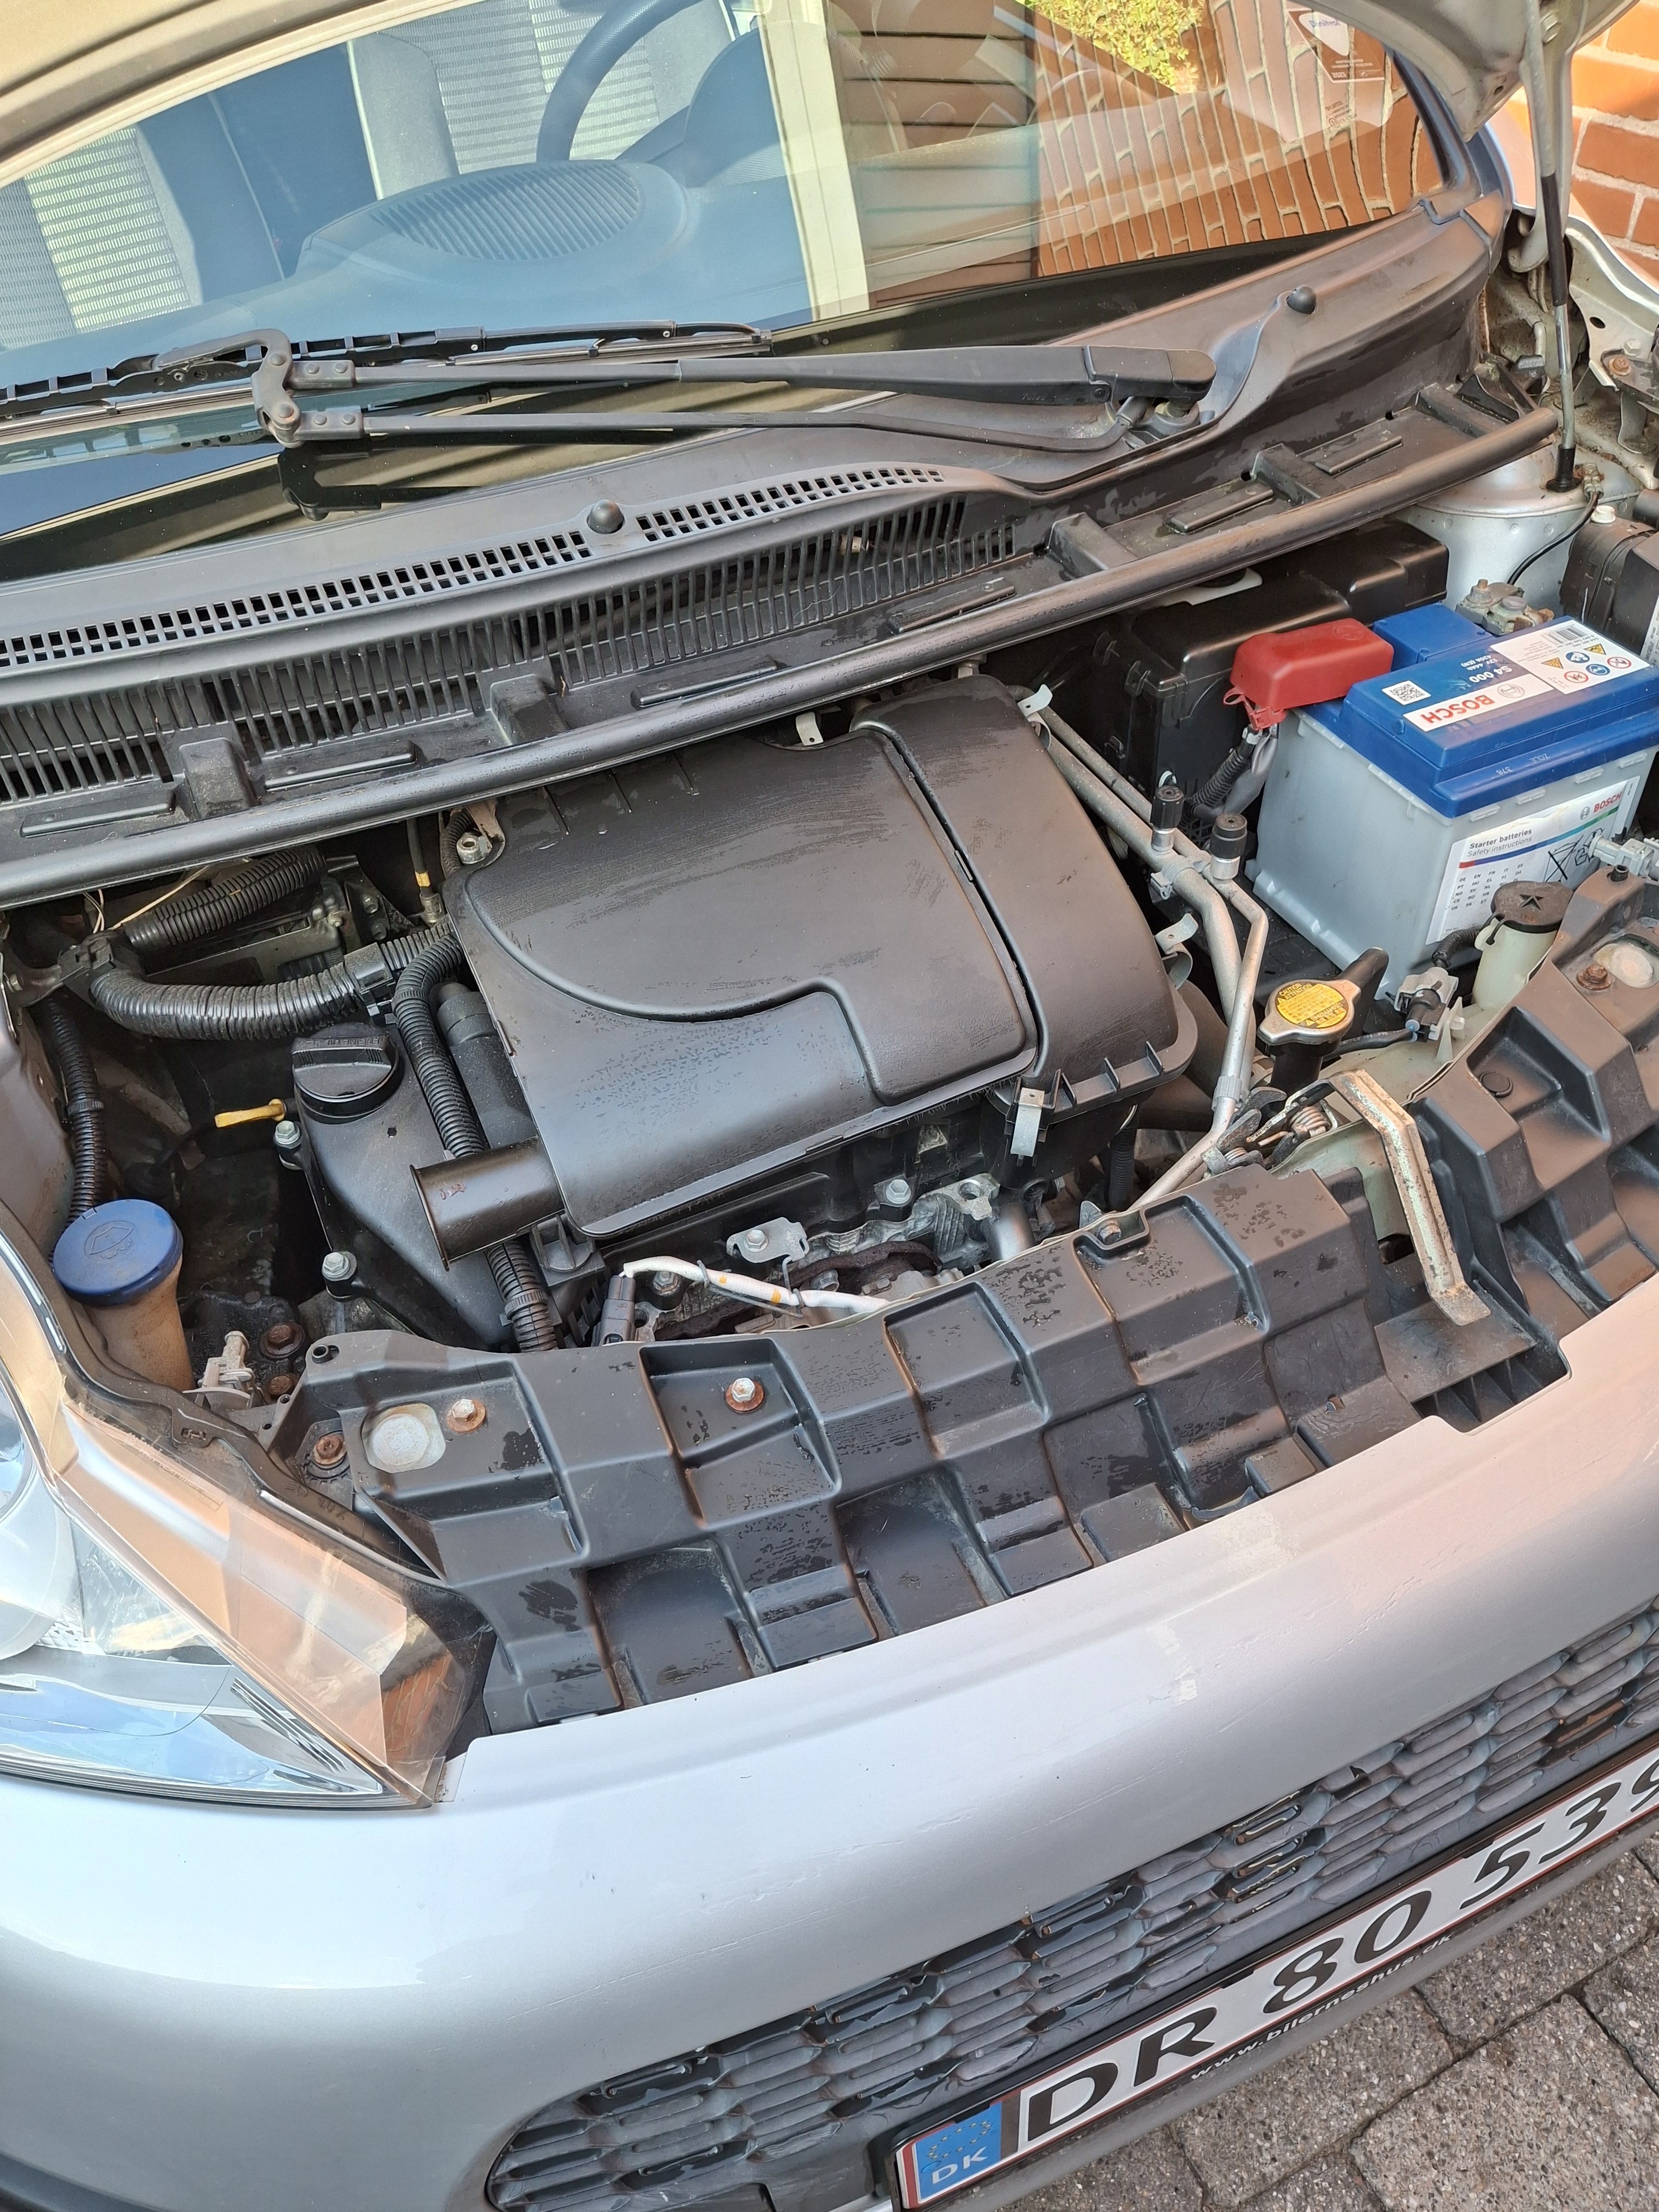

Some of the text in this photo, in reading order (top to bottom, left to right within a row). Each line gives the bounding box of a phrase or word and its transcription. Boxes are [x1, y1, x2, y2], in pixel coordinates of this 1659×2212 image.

[1461, 659, 1476, 667] (EN)
[1469, 666, 1512, 683] S4 000
[1420, 695, 1495, 723] BOSCH
[1496, 767, 1513, 775] 378
[1593, 791, 1623, 813] BOSCH
[1467, 836, 1532, 858] Safety instructions
[1469, 828, 1532, 850] Starter batteries
[1279, 982, 1302, 996] CAUTION
[1284, 983, 1313, 999] ATTENTION
[1028, 2007, 1218, 2142] DR
[1263, 1890, 1432, 2014] 80
[1191, 1933, 1452, 2080] www.bilerneshus.dk
[931, 2147, 989, 2185] DK
